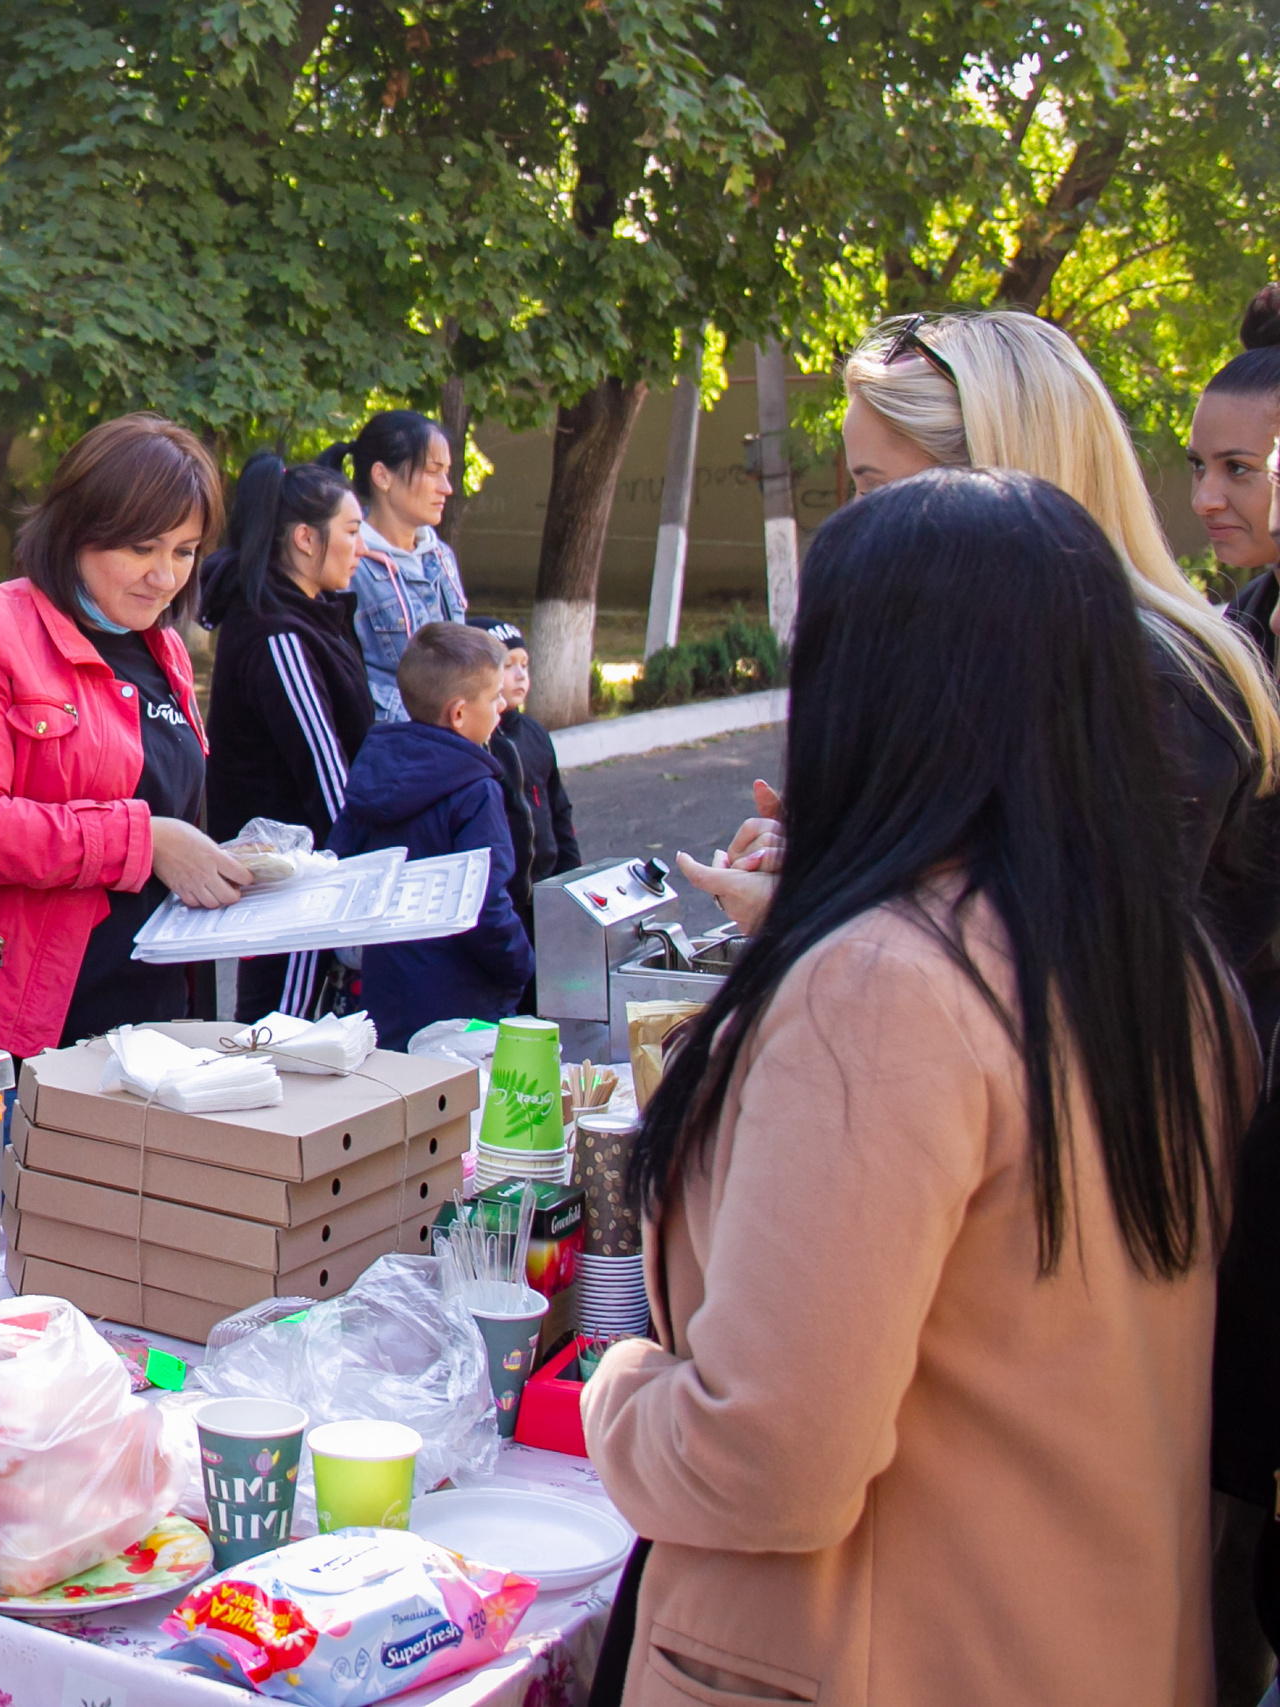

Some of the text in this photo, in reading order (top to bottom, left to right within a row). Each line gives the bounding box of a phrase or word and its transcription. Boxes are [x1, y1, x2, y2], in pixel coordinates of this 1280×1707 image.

[551, 1203, 581, 1235] Greenfield
[468, 1608, 487, 1632] 120
[385, 1621, 461, 1667] Superfresh
